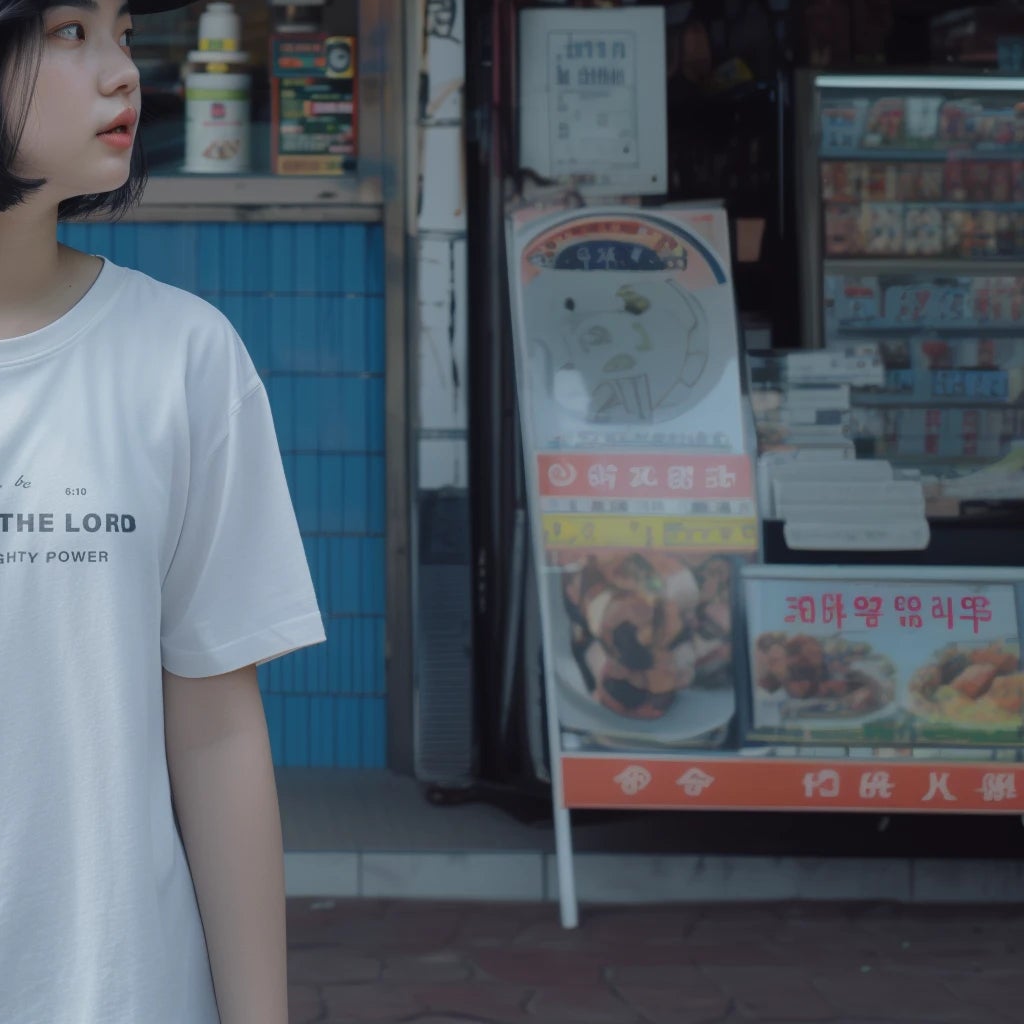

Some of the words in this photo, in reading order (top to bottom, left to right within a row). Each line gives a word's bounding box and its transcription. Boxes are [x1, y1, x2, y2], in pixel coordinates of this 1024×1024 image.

[14, 474, 32, 489] be
[64, 487, 87, 496] 6:10
[65, 513, 137, 533] LORD
[46, 551, 109, 563] POWER
